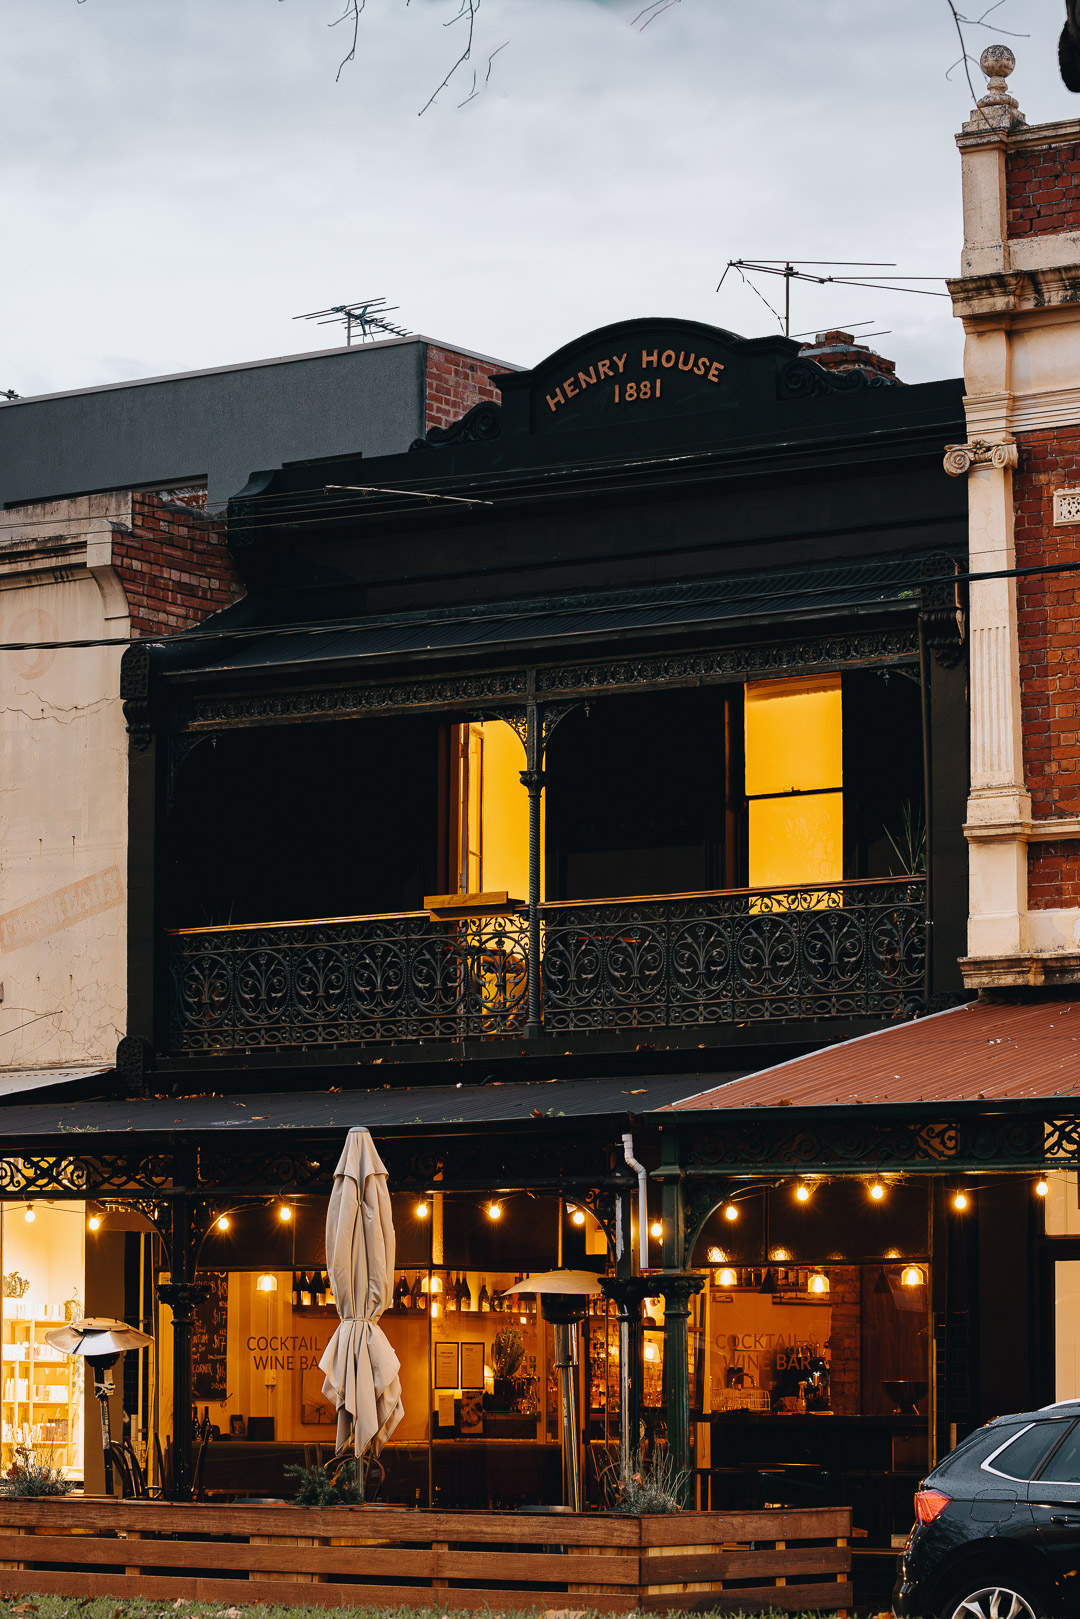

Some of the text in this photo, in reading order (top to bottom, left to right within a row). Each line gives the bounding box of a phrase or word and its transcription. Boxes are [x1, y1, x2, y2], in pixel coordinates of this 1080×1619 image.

[545, 349, 725, 412] HENRY HOUSE
[614, 378, 661, 403] 1881
[247, 1336, 321, 1351] COCKTAIL
[715, 1333, 800, 1349] COCKTAIL
[253, 1356, 320, 1370] WINE BA
[723, 1354, 812, 1370] WINE BAR
